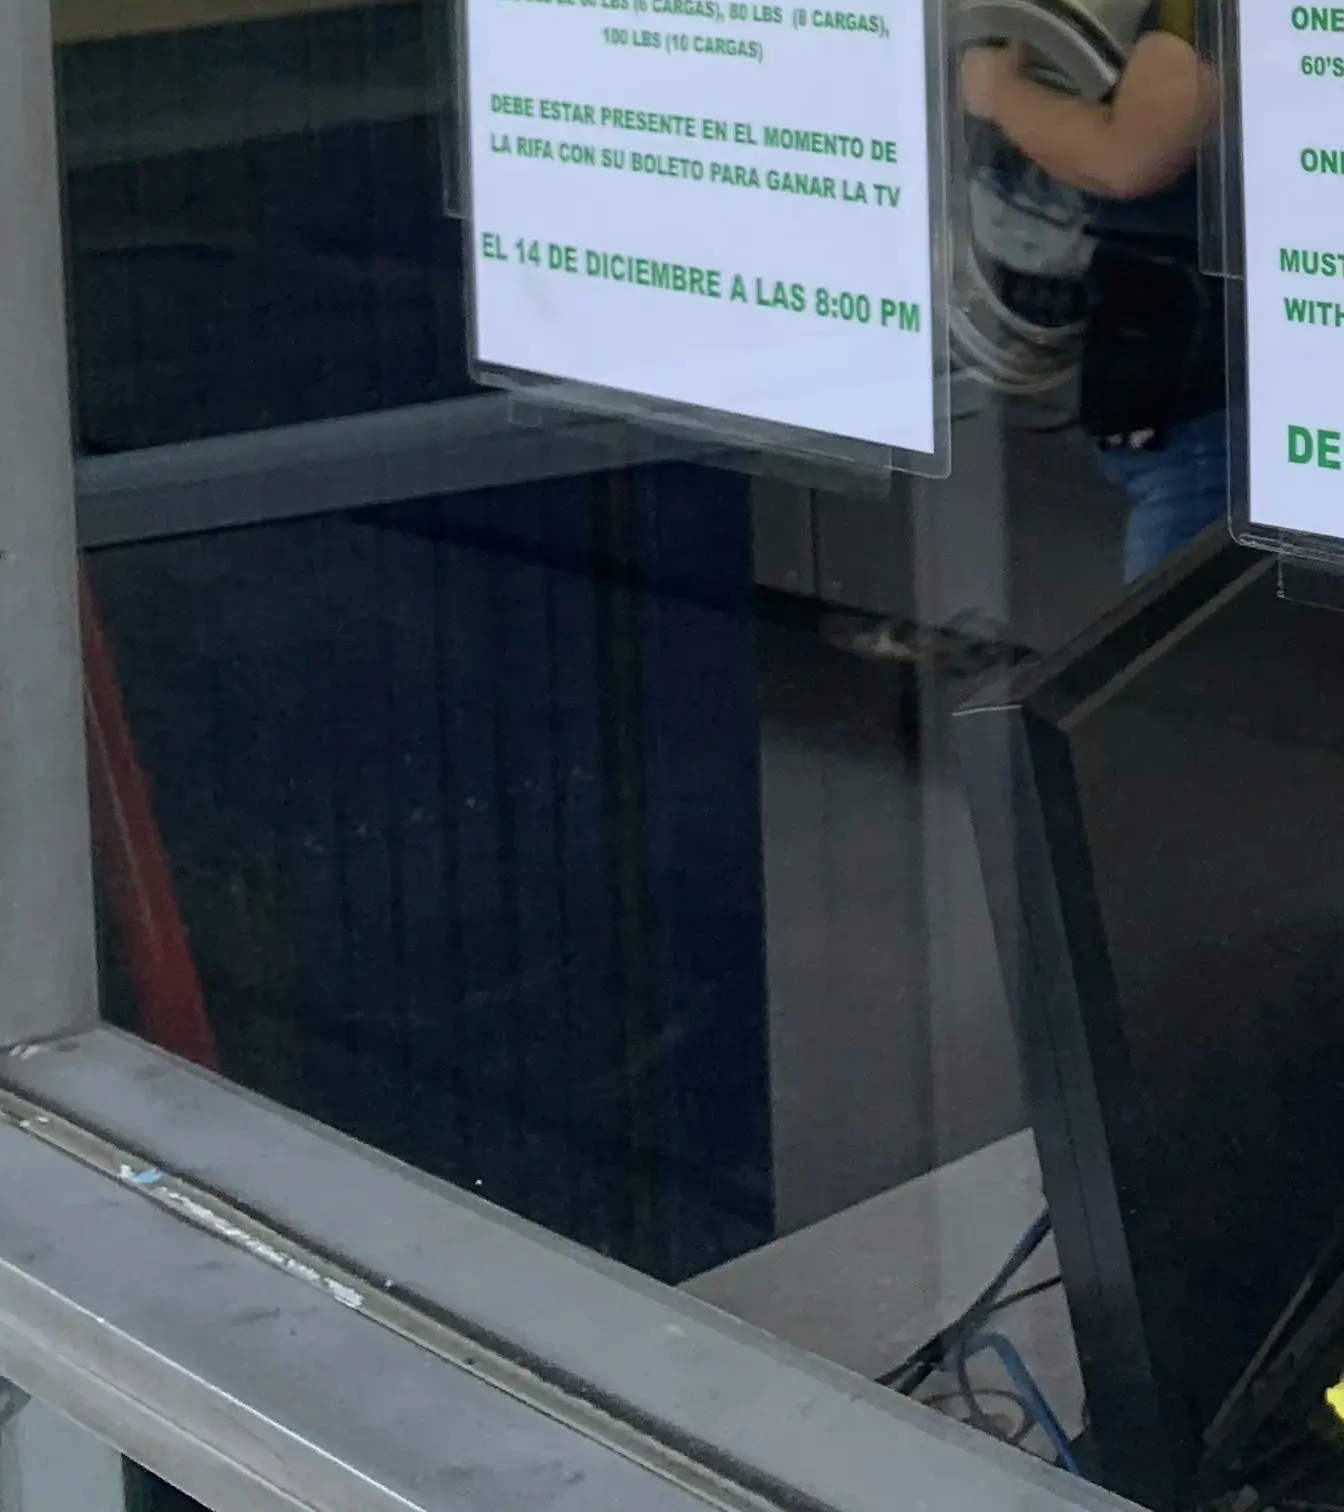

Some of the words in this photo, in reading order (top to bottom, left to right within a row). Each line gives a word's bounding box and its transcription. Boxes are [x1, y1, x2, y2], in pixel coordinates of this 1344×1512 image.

[480, 230, 509, 262] EL
[514, 237, 542, 268] 14
[546, 241, 579, 275] DE
[584, 248, 723, 300] DICIEMBRE
[728, 272, 749, 304] A
[754, 276, 807, 314] LAS
[813, 286, 872, 325] 8:00
[879, 296, 922, 334] PM
